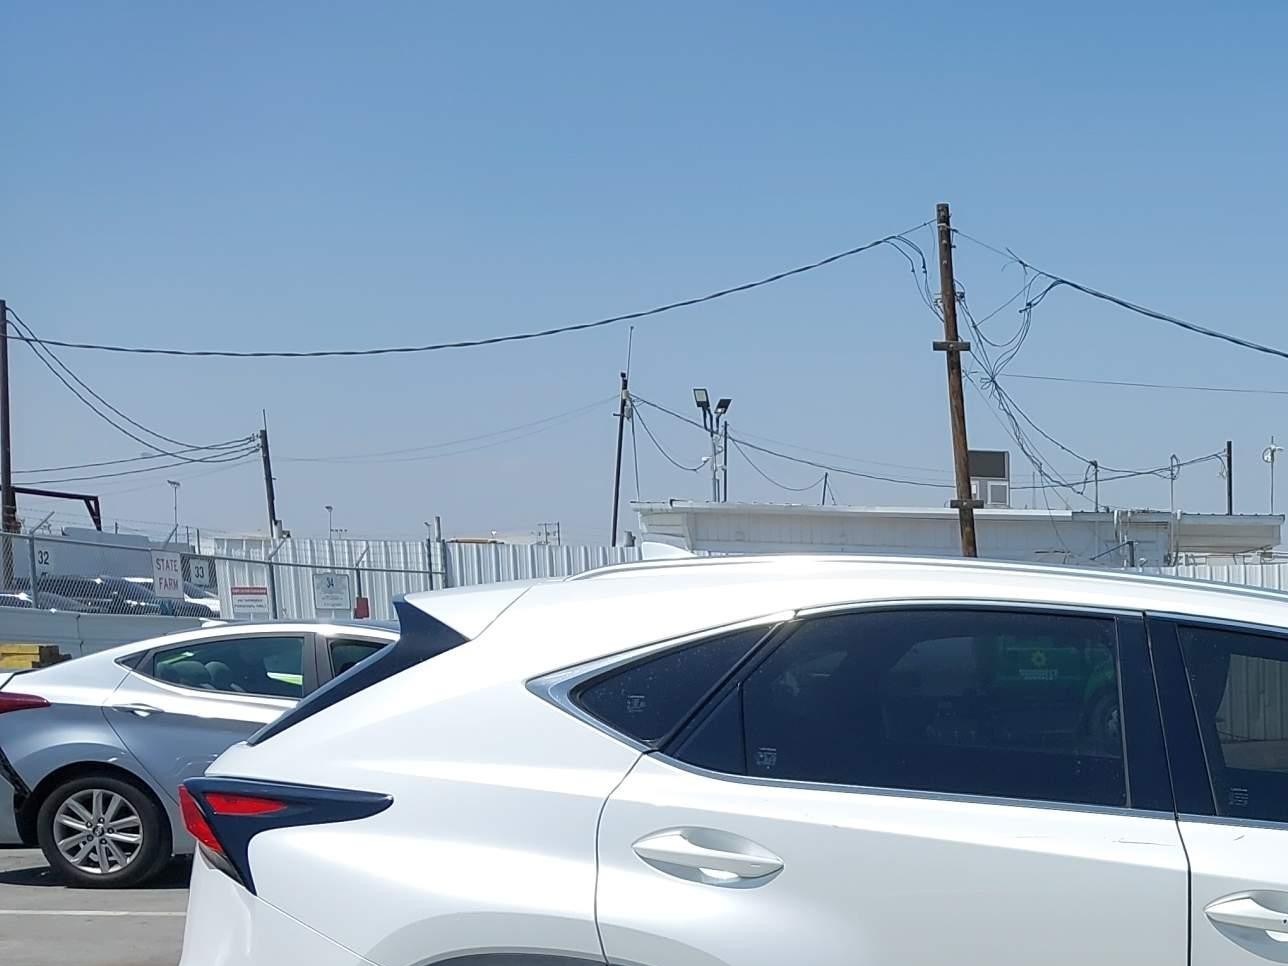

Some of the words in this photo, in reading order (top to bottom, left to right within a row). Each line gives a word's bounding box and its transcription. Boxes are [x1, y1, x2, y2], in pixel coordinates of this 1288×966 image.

[38, 551, 49, 565] 32
[155, 558, 178, 571] STATE
[194, 566, 204, 578] 33
[159, 578, 178, 591] FARM
